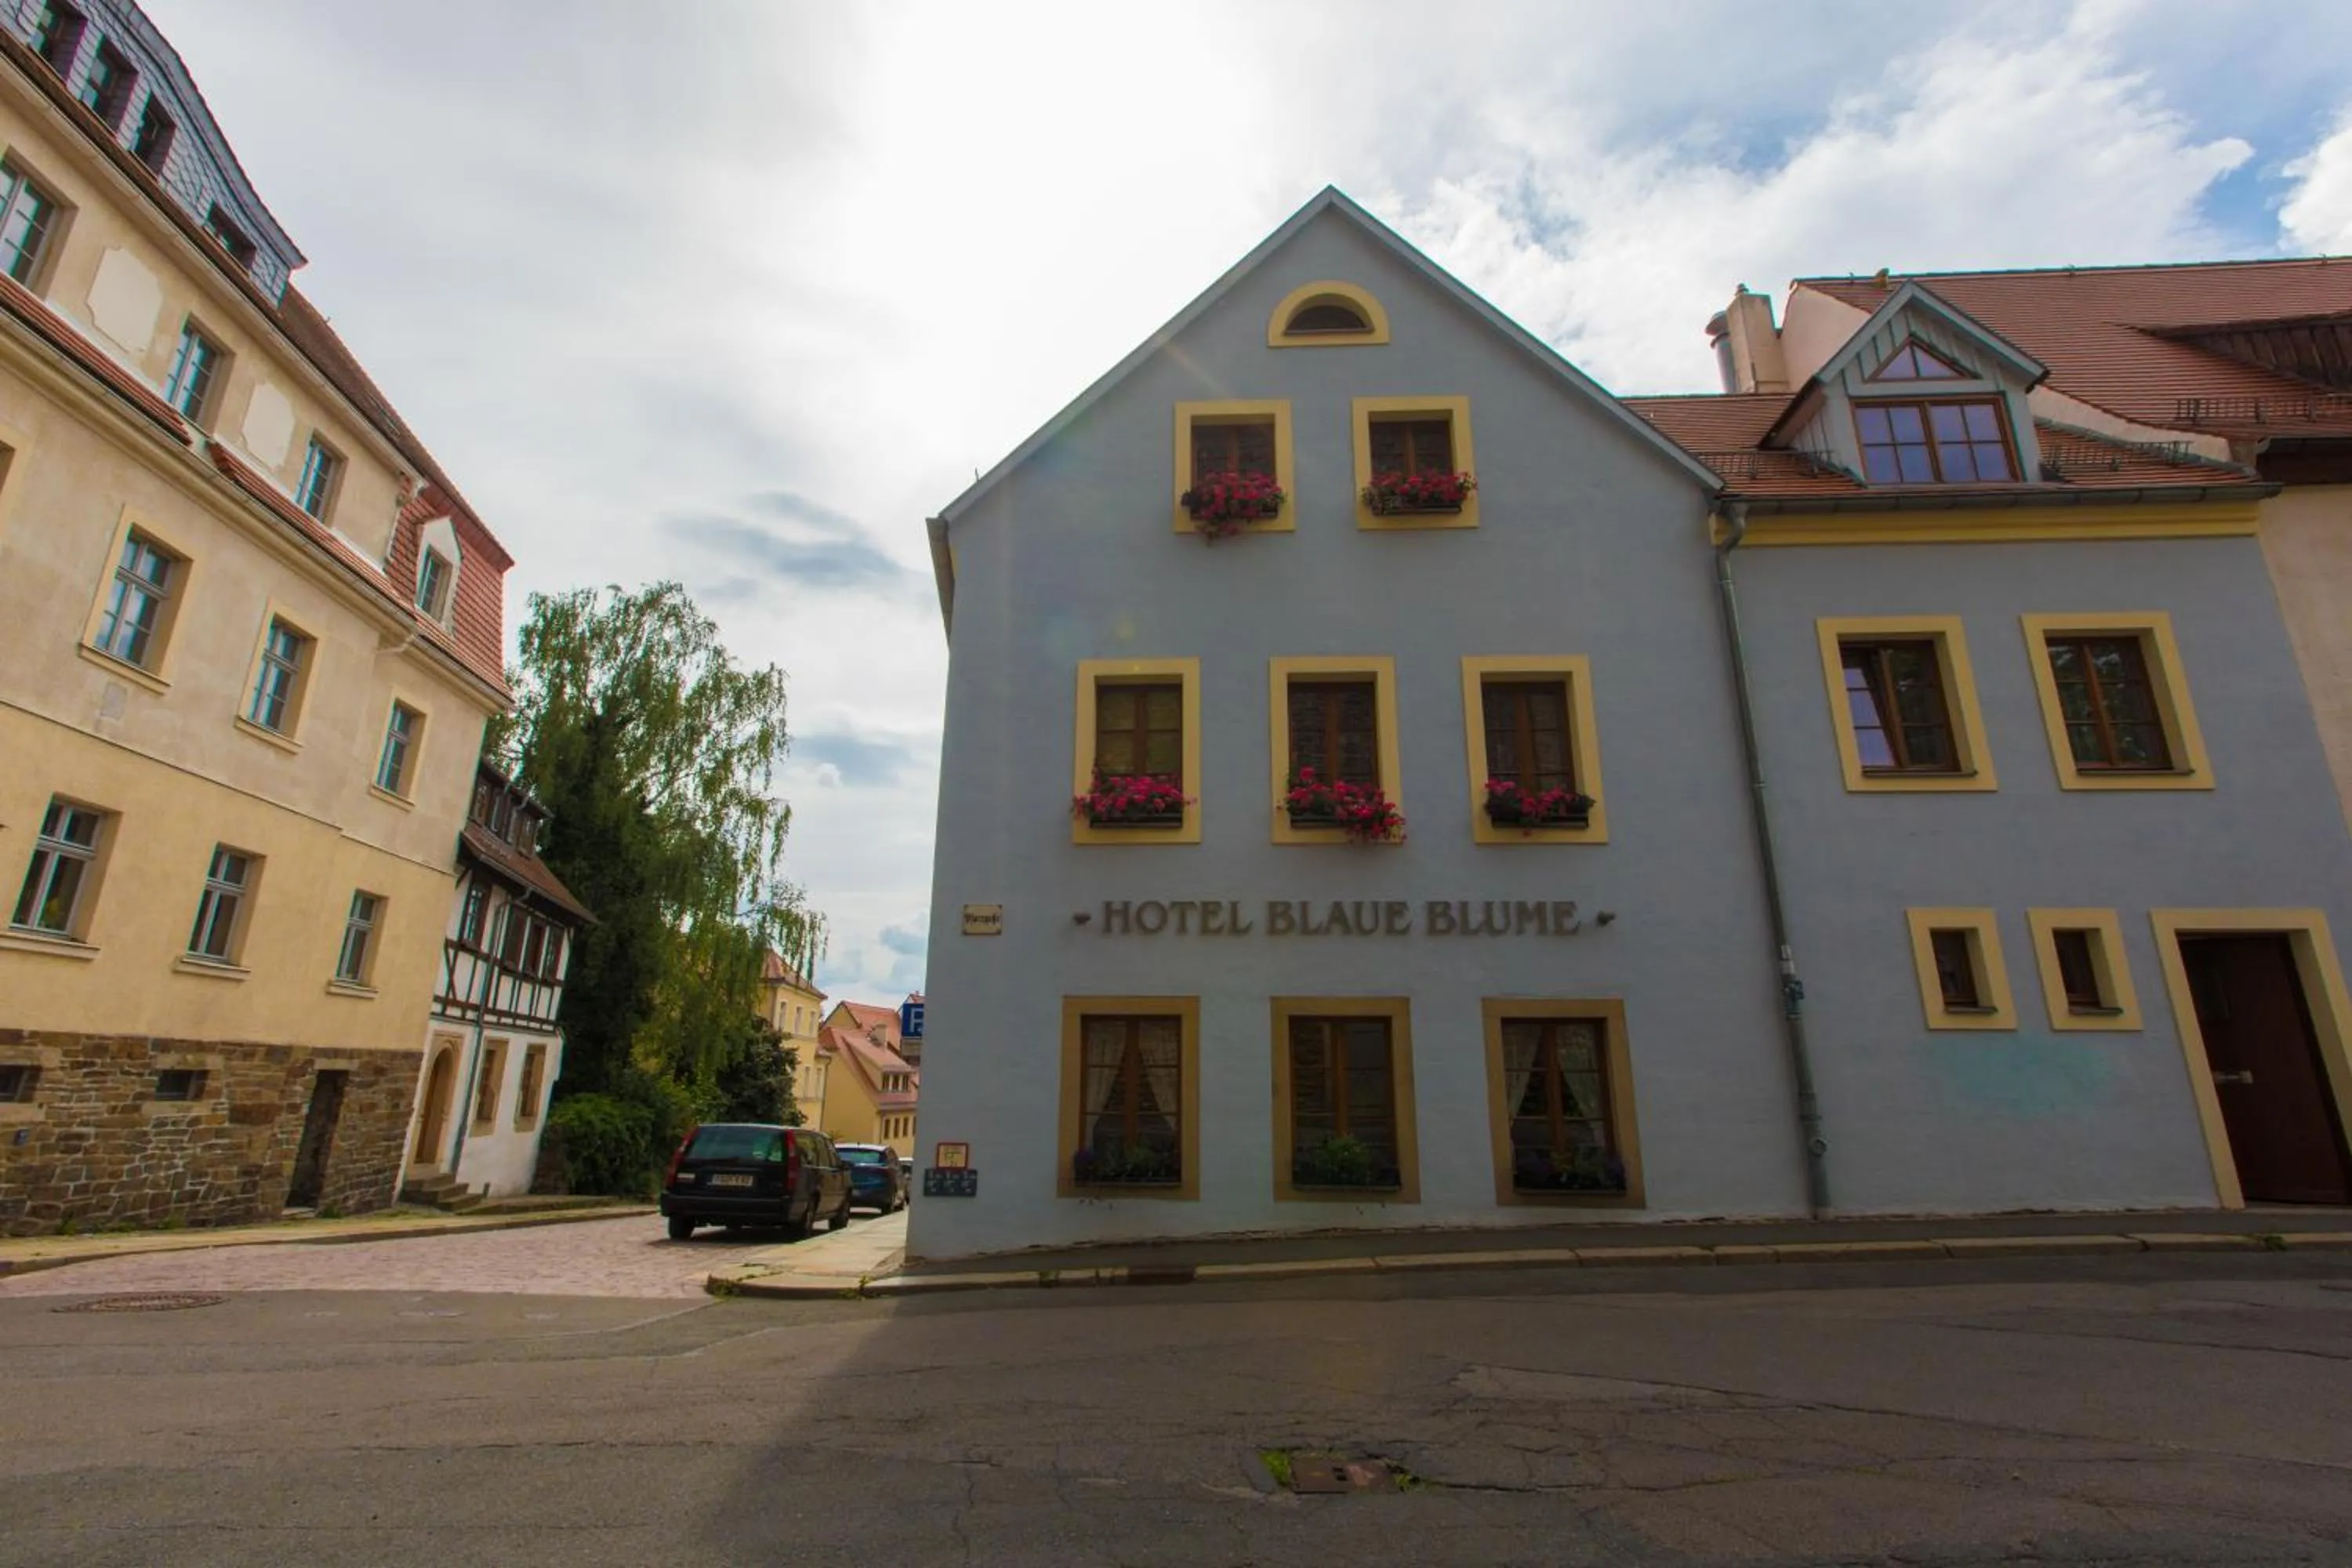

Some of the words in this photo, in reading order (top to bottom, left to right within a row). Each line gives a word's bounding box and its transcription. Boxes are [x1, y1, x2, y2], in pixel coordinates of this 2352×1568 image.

[1102, 901, 1253, 935] HOTEL
[1265, 901, 1411, 935] BLAUE
[1425, 901, 1581, 936] BLUME
